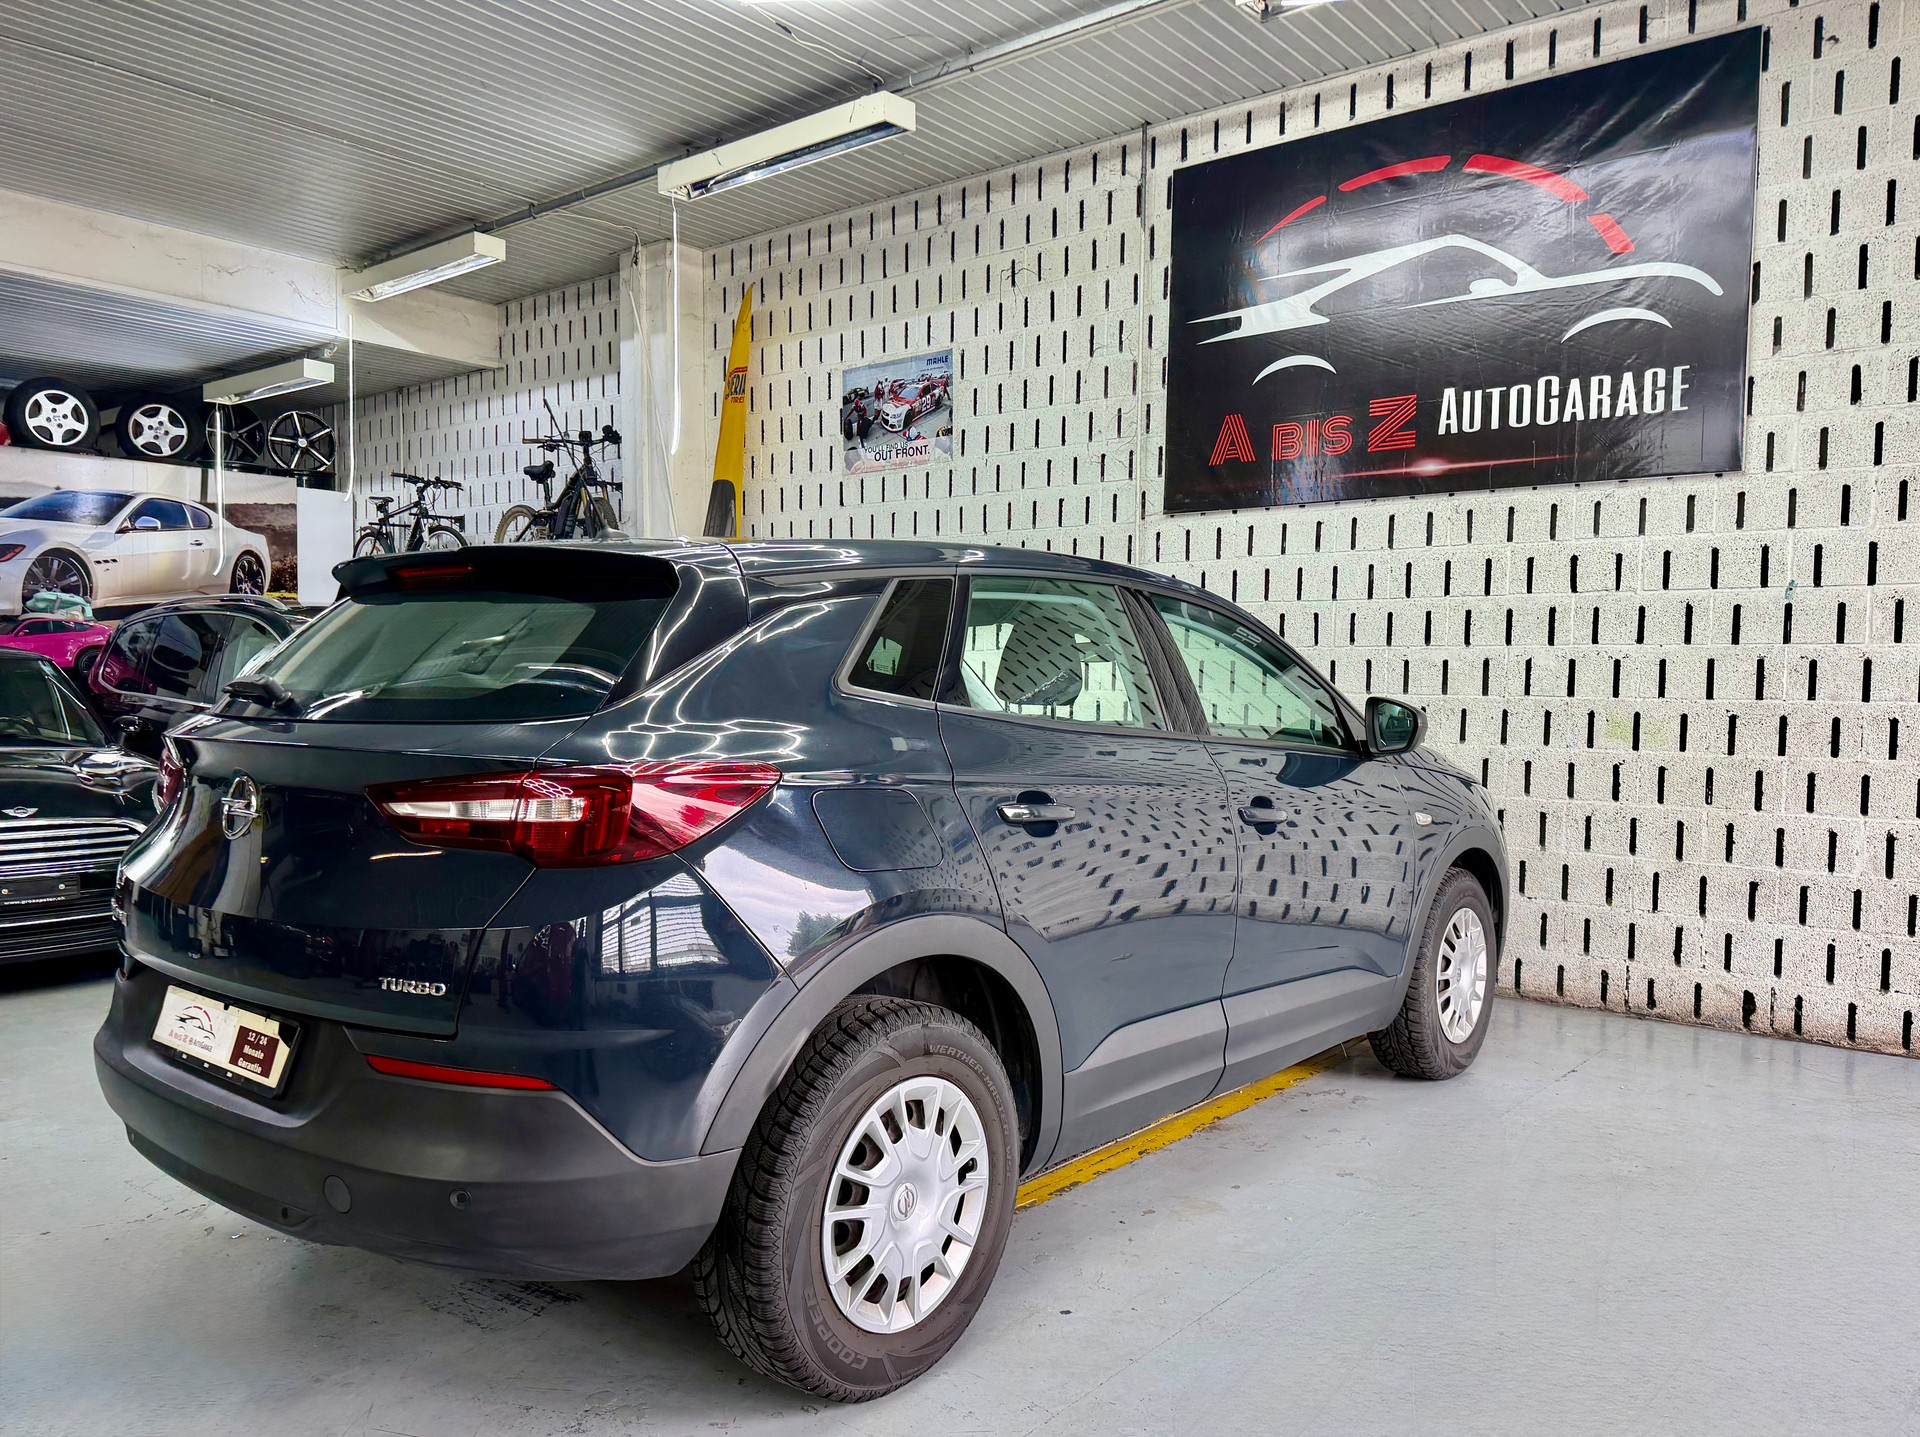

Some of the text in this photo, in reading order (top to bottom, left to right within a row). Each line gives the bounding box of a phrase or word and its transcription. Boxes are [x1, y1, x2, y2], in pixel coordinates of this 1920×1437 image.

[926, 355, 949, 366] MAHLE
[1209, 365, 1691, 466] A BIS Z AUTOGARAGE
[874, 444, 931, 462] OUT FRONT.
[886, 442, 898, 450] FIND
[900, 441, 909, 449] US
[378, 977, 447, 997] TURBO
[242, 1044, 265, 1060] Monate
[237, 1057, 263, 1074] Garantie
